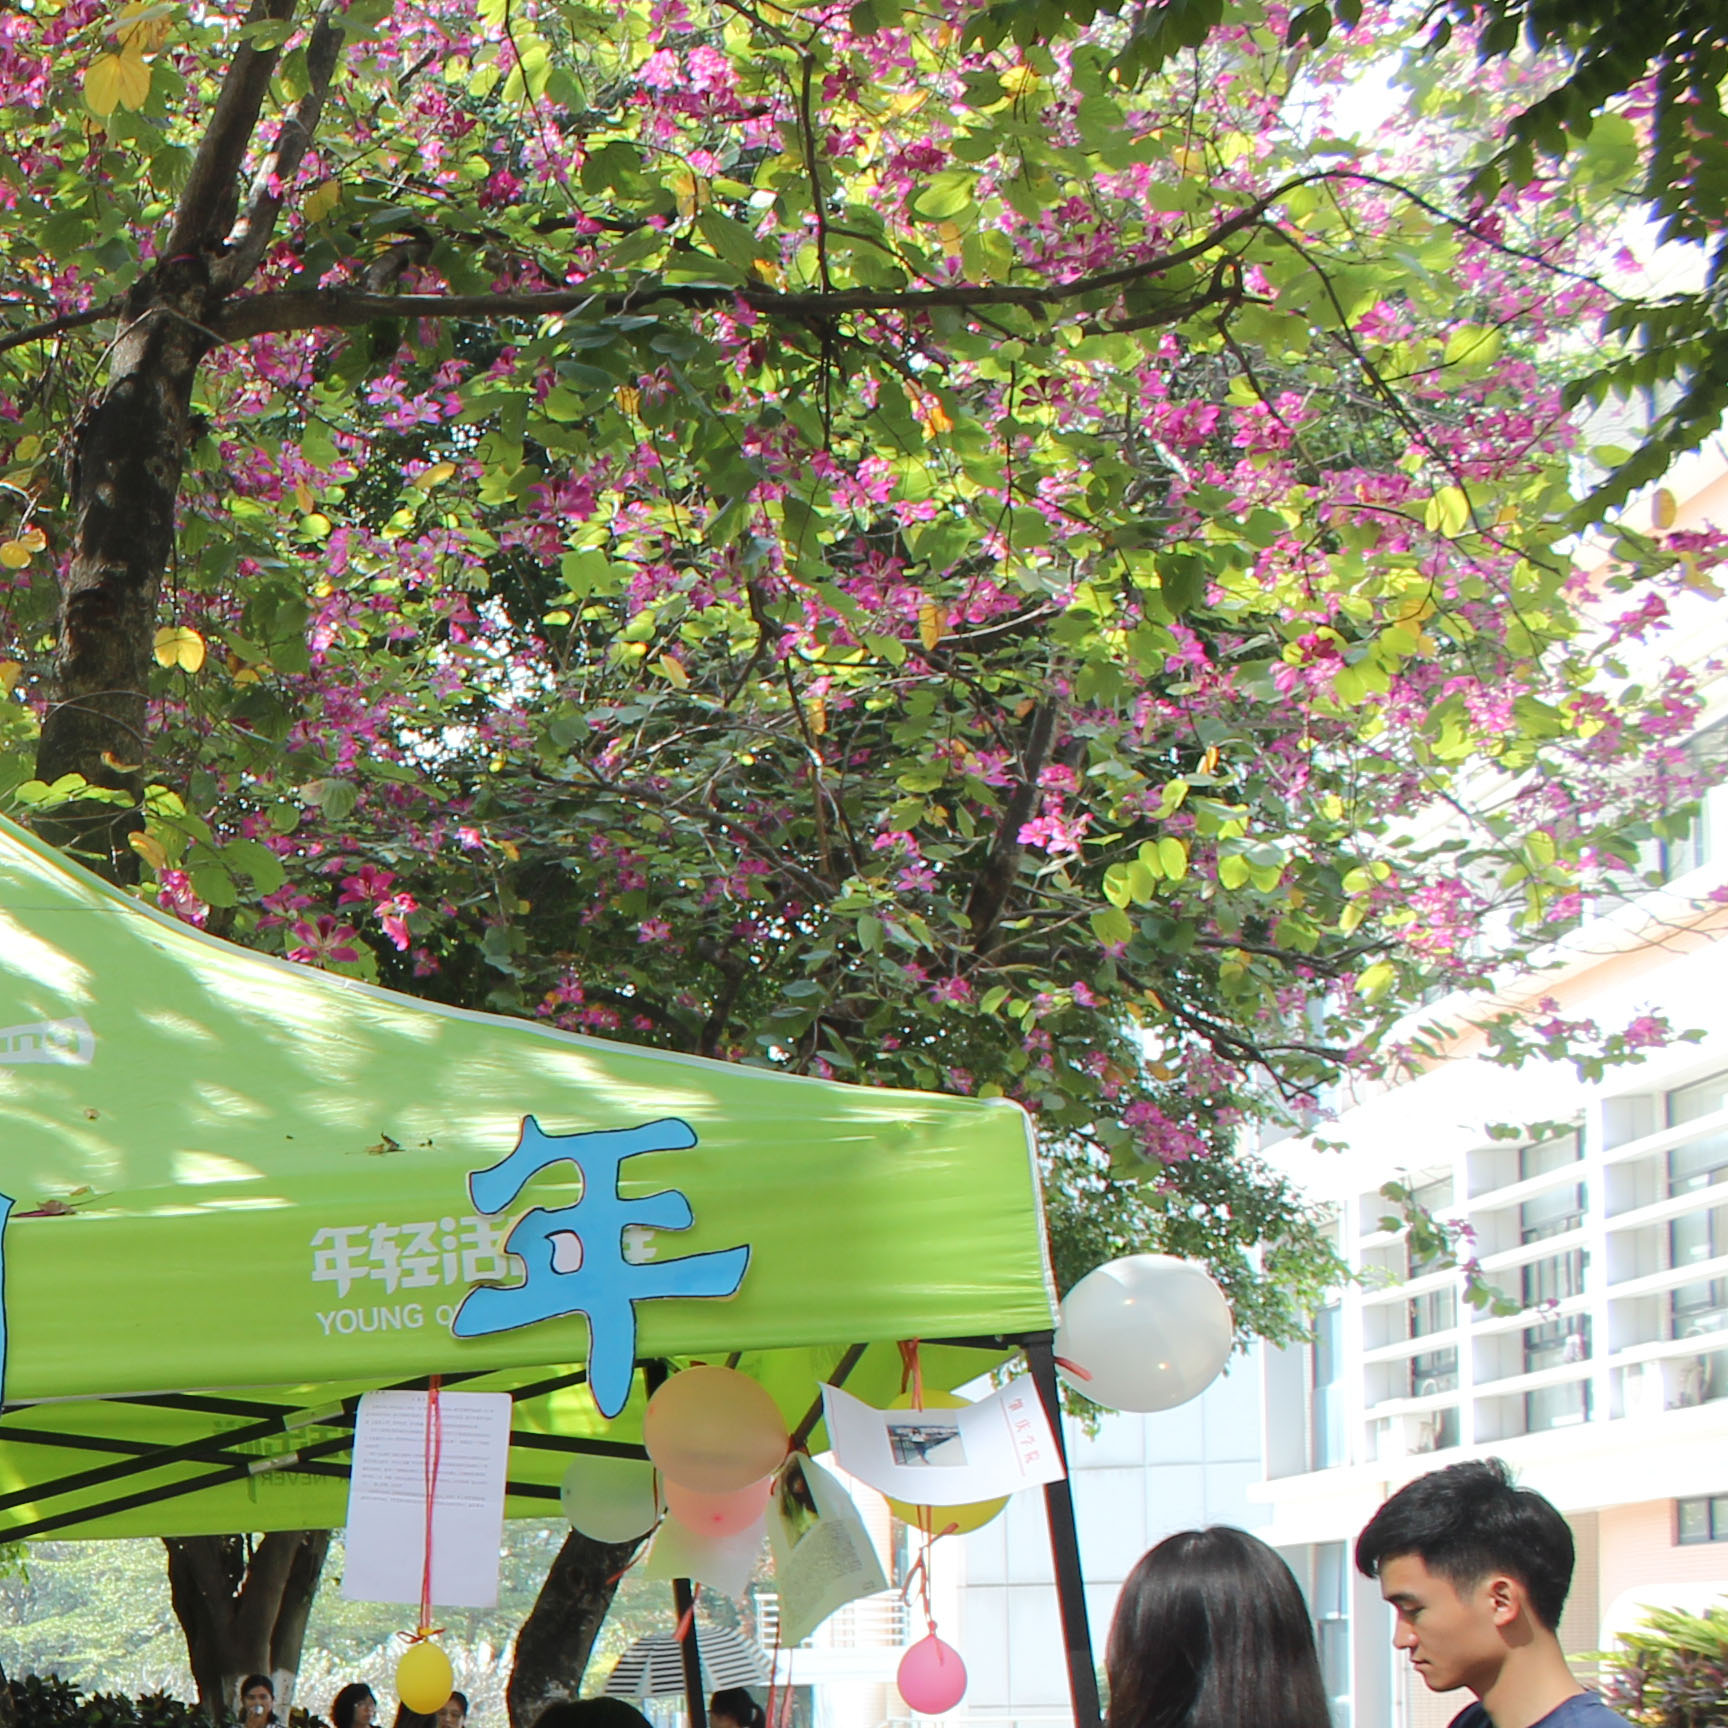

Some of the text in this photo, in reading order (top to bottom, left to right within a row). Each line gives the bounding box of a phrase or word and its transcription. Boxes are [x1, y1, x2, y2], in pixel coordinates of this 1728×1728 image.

[316, 1303, 456, 1336] YOUNG O
[451, 1113, 751, 1420] 年
